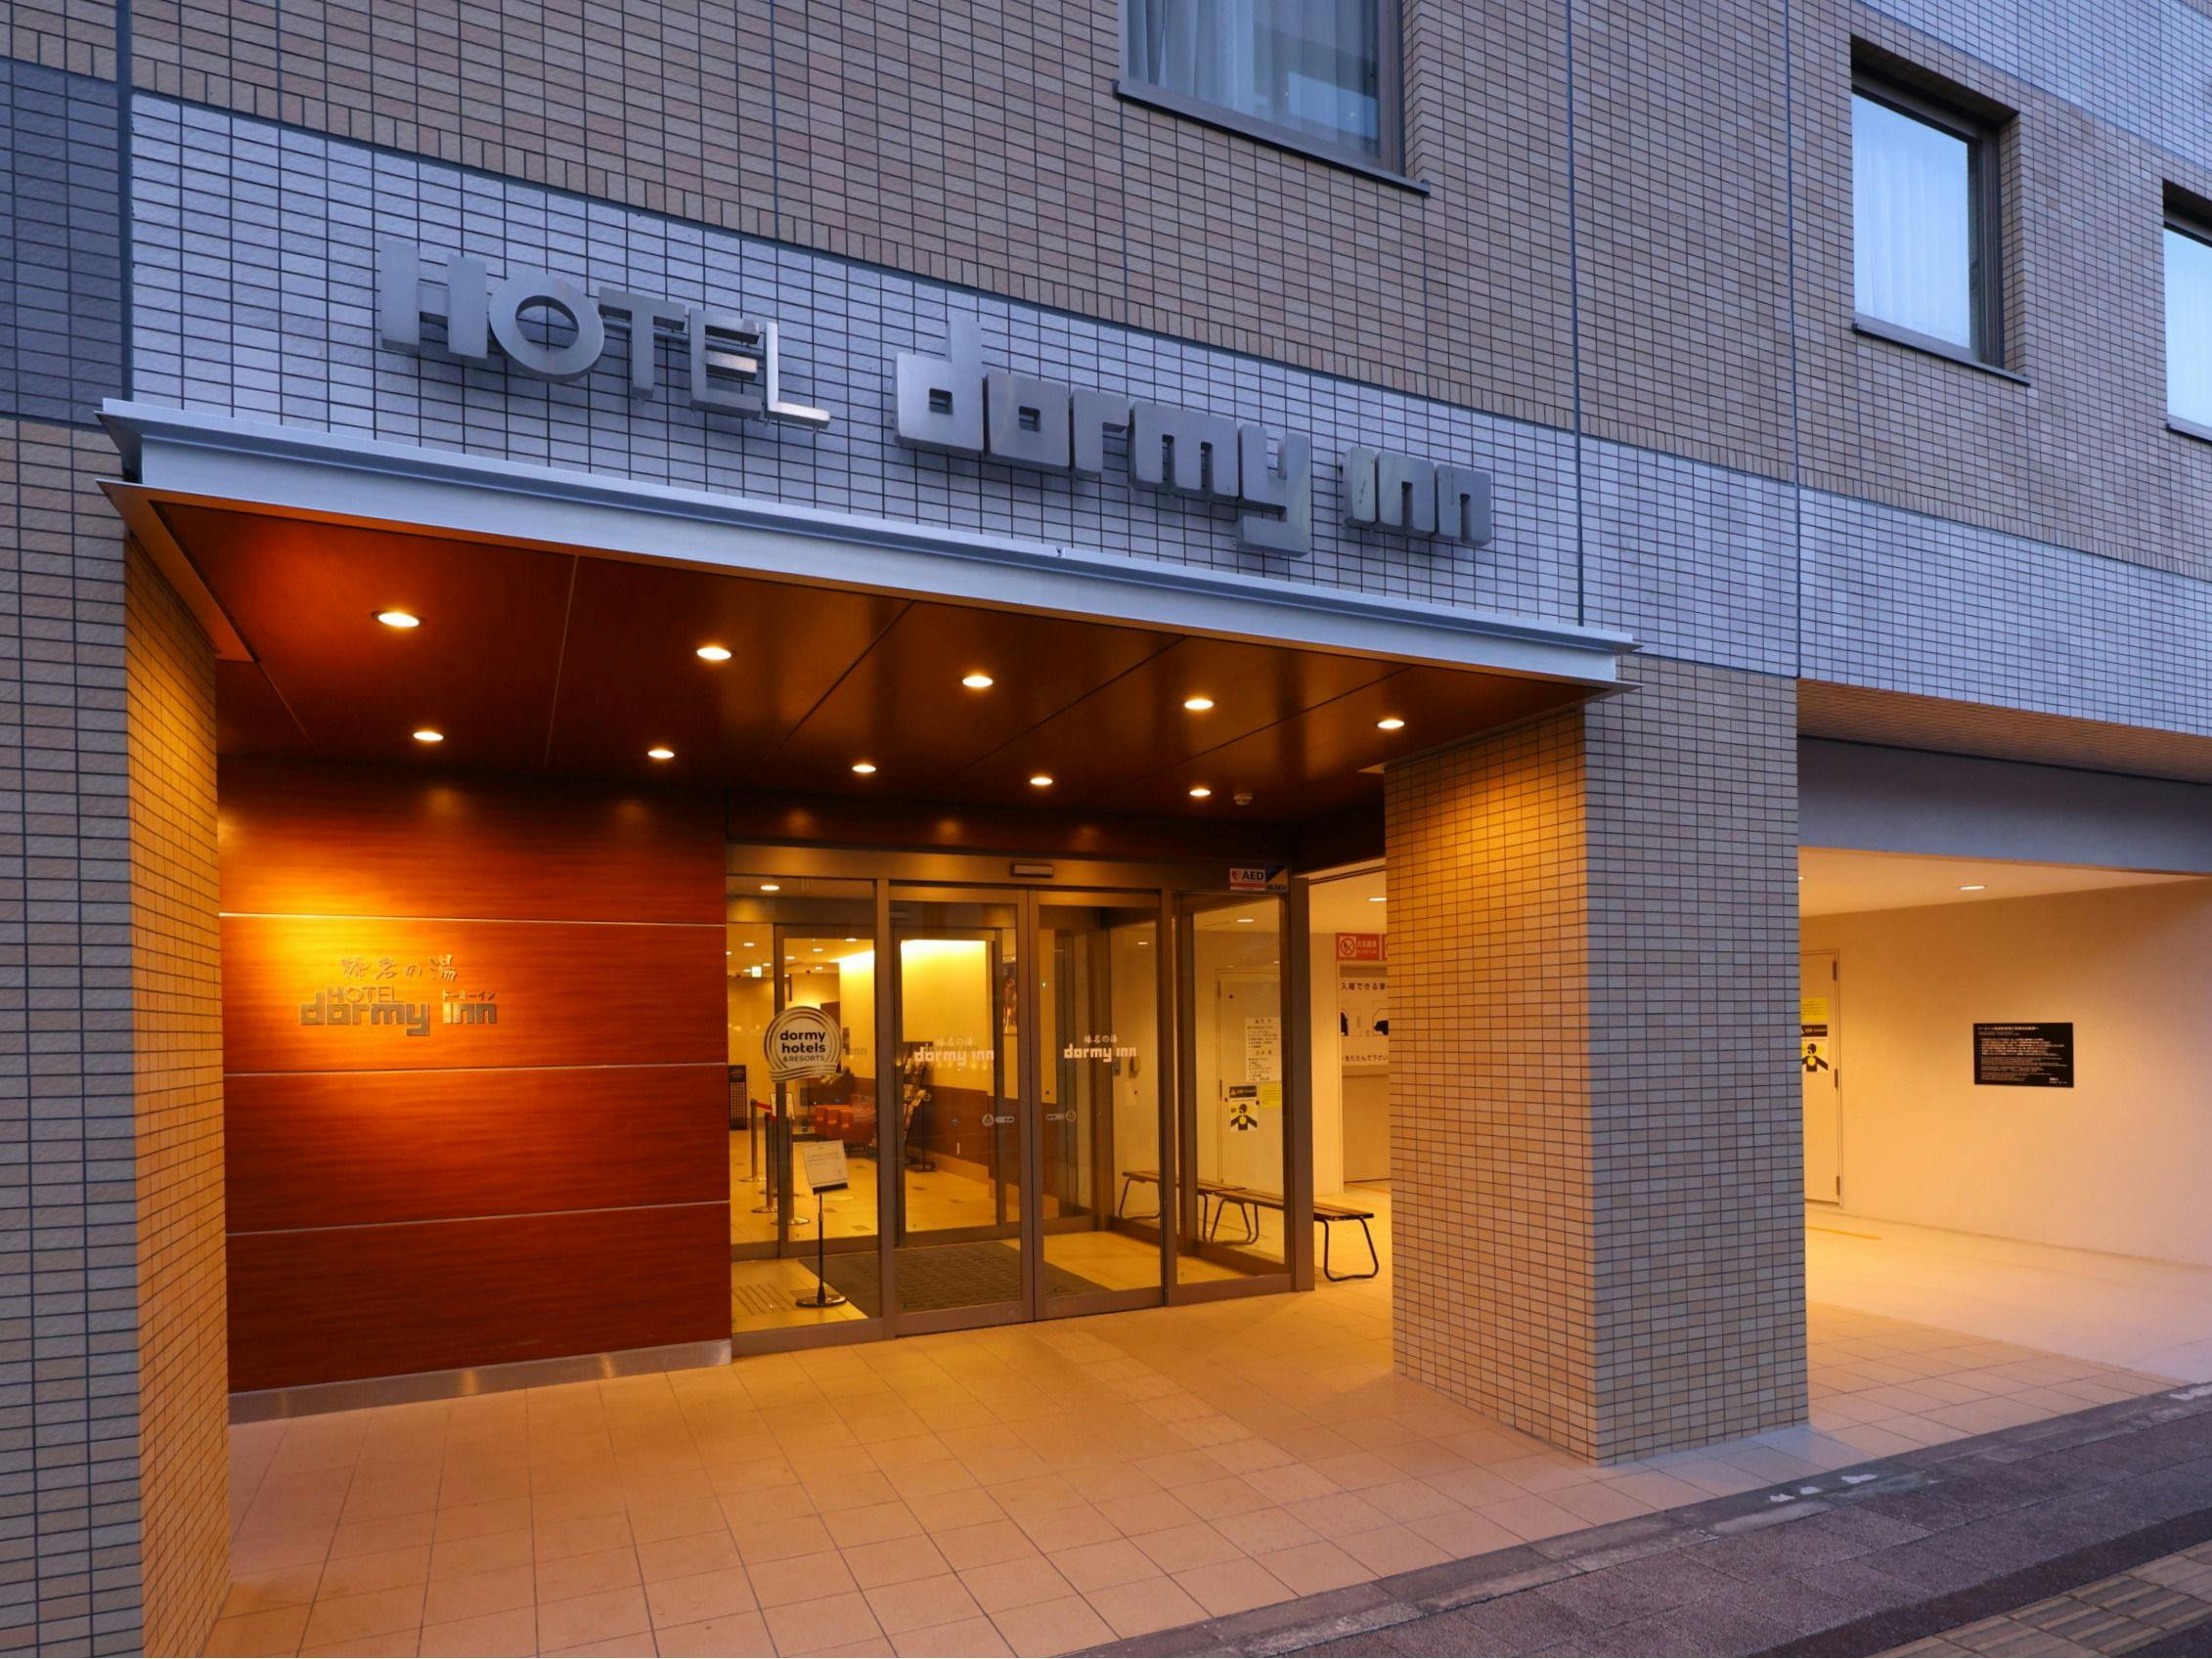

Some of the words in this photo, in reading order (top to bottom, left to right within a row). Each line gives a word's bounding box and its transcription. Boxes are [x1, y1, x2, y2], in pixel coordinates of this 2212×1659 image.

[379, 240, 831, 431] HOTEL
[893, 315, 1311, 557] dormy
[1343, 446, 1493, 547] inn
[1243, 870, 1264, 880] AED
[327, 985, 403, 1004] HOTEL
[442, 990, 496, 1001] ドーミーイン
[299, 992, 430, 1036] dormy
[442, 1003, 497, 1025] inn
[779, 1030, 825, 1042] dormy
[782, 1042, 826, 1053] hotels
[913, 1046, 966, 1067] dormy
[971, 1050, 995, 1061] inn
[1063, 1043, 1112, 1063] dormy
[1116, 1047, 1137, 1057] inn
